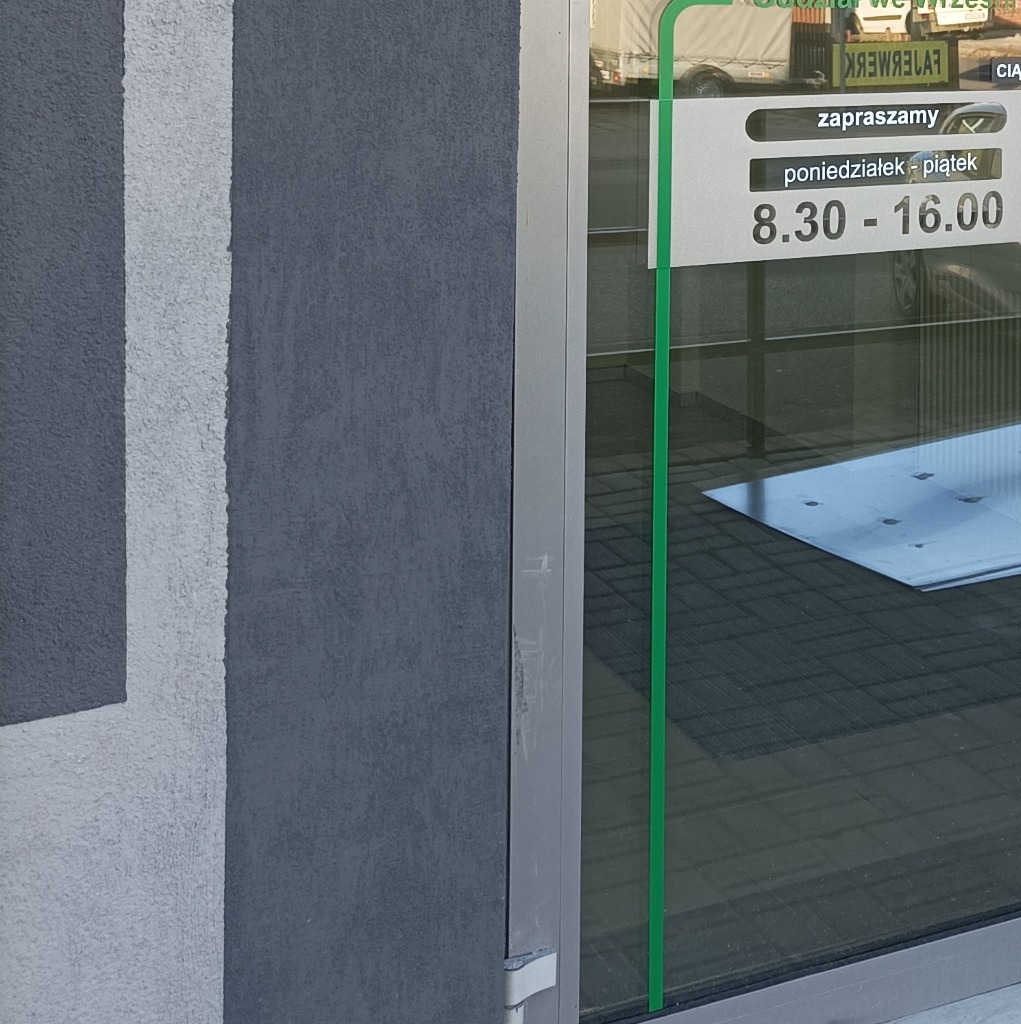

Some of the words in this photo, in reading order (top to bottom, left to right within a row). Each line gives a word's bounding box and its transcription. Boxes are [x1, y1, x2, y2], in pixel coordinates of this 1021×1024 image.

[817, 108, 940, 131] zapraszamy
[784, 157, 906, 187] poniedziałek
[923, 152, 978, 178] piątek
[752, 199, 846, 244] 8.30
[863, 218, 878, 227] -
[894, 190, 1004, 235] 16.00
